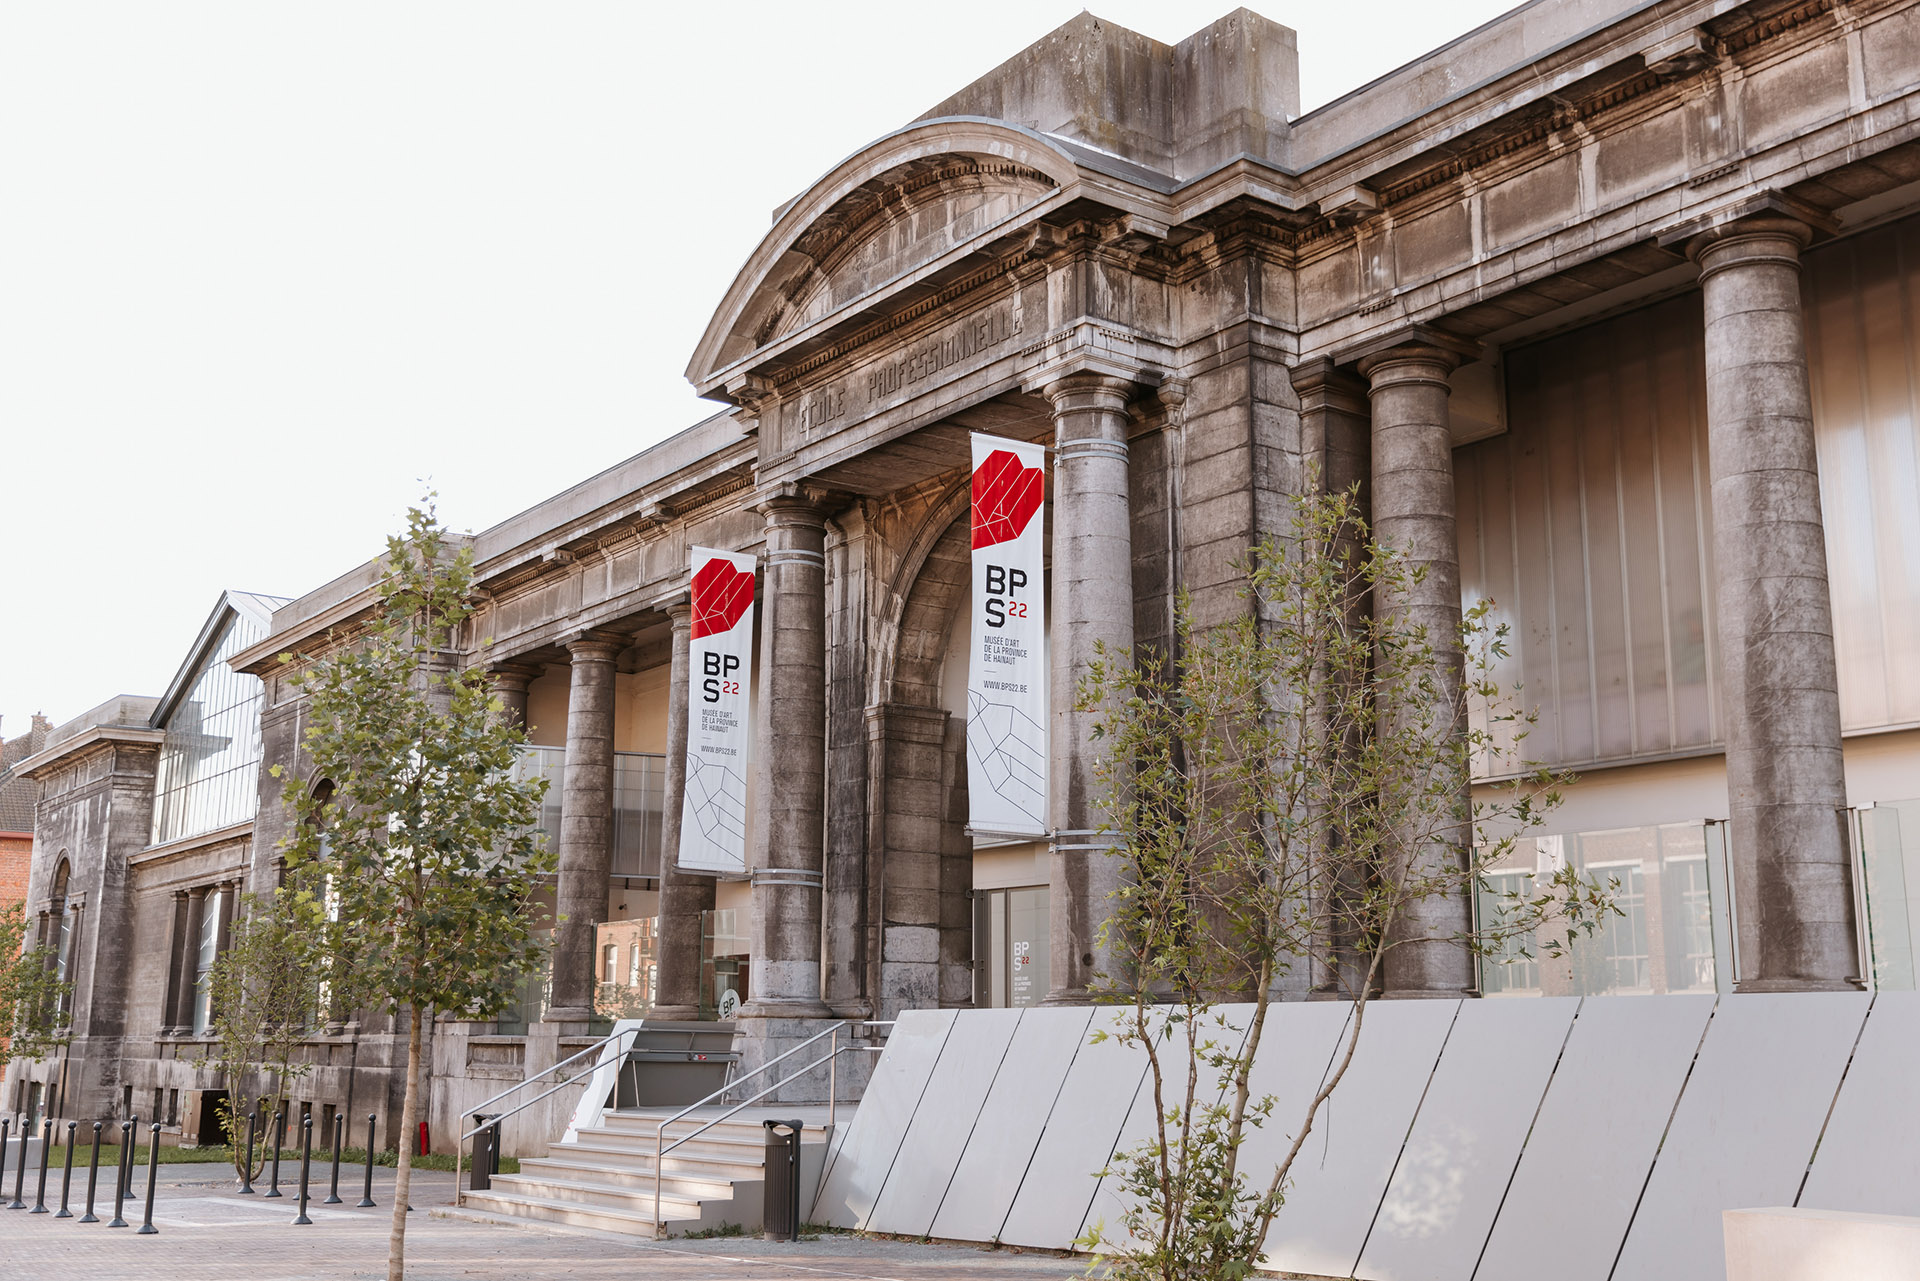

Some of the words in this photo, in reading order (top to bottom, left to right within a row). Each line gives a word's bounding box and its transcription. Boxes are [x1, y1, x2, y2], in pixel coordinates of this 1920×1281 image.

[867, 303, 1023, 404] PROFESSIONNELLE
[986, 564, 1028, 597] BP
[984, 635, 1004, 646] MUSÉE
[1004, 637, 1020, 648] D'ART
[984, 644, 991, 653] DE
[994, 646, 1000, 654] LA
[1001, 646, 1028, 659] PROVINCE
[703, 651, 740, 678] BP
[984, 653, 991, 662] DE
[993, 655, 1015, 665] HAINAUT
[983, 680, 1028, 693] WWW.BPS22.BE
[702, 709, 718, 717] MUSÉE
[719, 711, 732, 719] D'ART
[709, 725, 728, 733] HAINAUT
[716, 718, 738, 727] PROVINCE
[701, 745, 737, 757] WWW.BPS22.BE
[1014, 942, 1030, 956] BP
[723, 997, 735, 1014] BP
